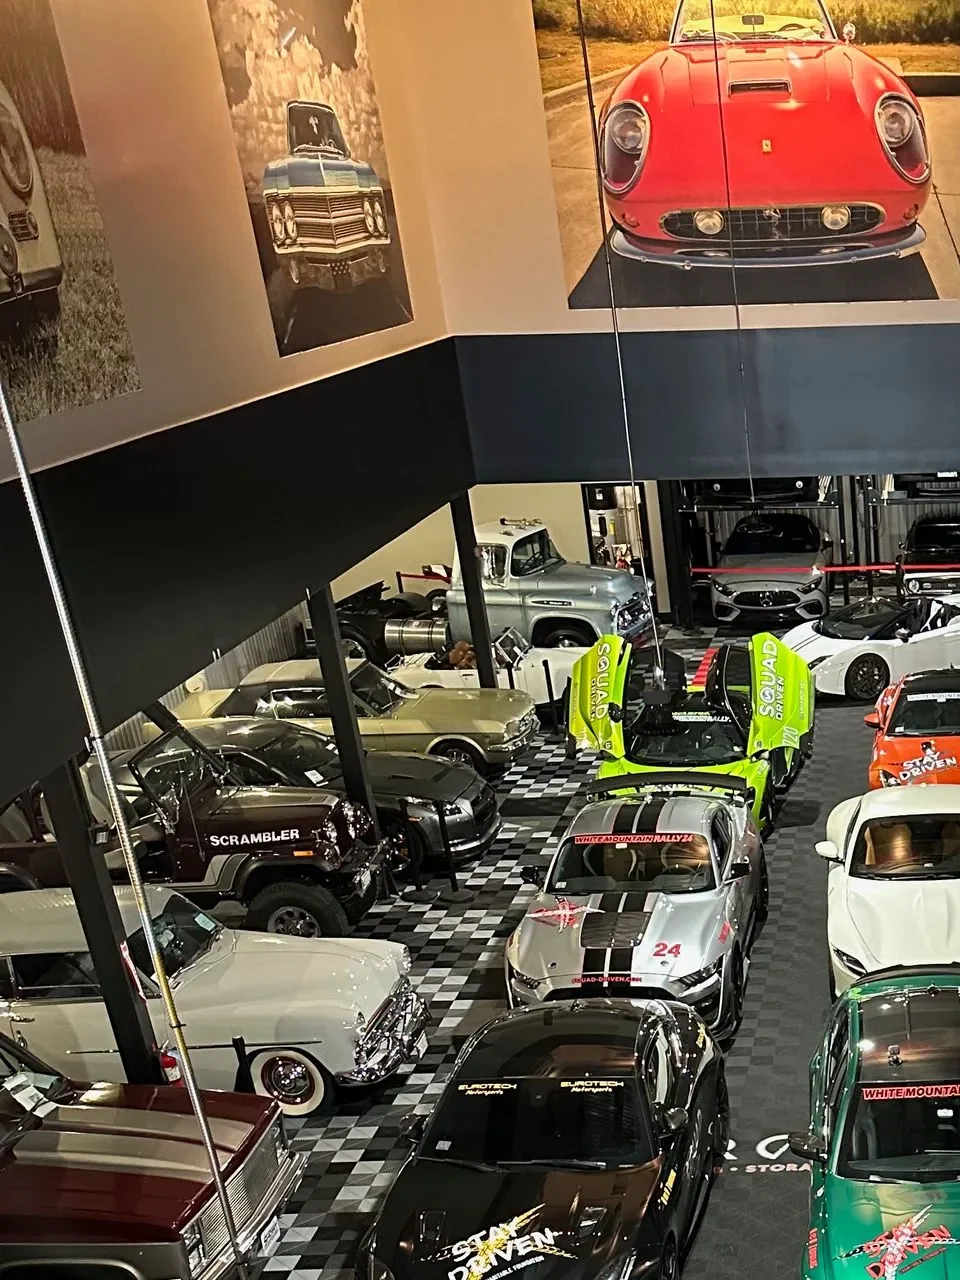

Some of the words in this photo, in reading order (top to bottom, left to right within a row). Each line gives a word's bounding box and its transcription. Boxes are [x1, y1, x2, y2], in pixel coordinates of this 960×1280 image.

[595, 642, 611, 719] SQUAD
[758, 639, 778, 719] SQUAD
[775, 676, 785, 721] DRIVEN
[900, 756, 957, 780] DRIVEN
[902, 751, 941, 770] STAY
[210, 829, 300, 846] SCRAMBLER
[575, 835, 605, 844] WHITE
[605, 835, 653, 844] MOUNTAIN
[653, 833, 694, 843] RALLY24
[653, 942, 682, 958] 24
[457, 1083, 518, 1091] EUROTECH
[560, 1080, 625, 1088] EUROTECH
[861, 1087, 904, 1100] WHITE
[744, 1162, 812, 1174] STORA
[451, 1216, 519, 1263] STAY
